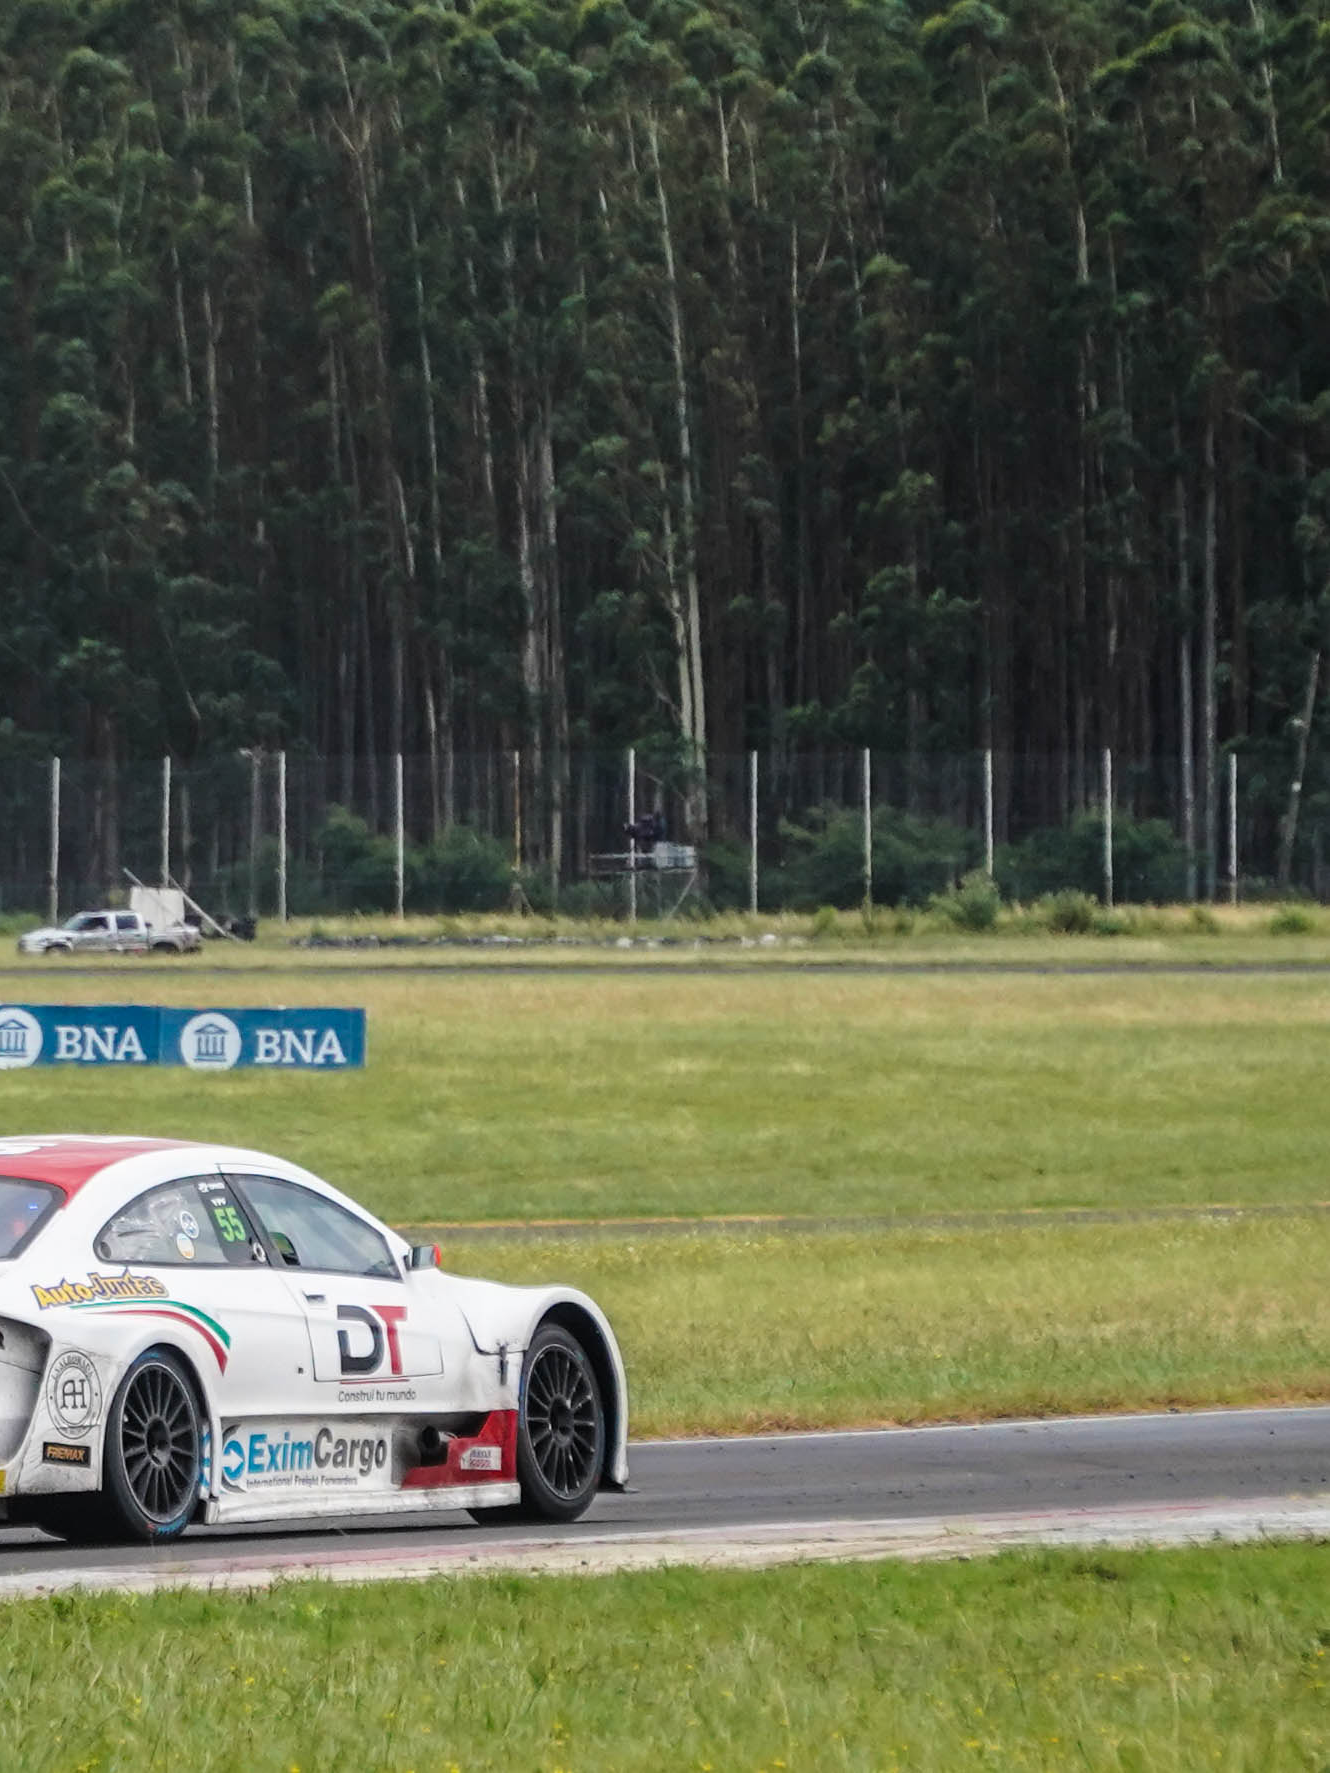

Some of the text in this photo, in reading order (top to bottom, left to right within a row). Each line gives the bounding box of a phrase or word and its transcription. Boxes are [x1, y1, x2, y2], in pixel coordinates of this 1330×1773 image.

[54, 1025, 147, 1062] BNA
[254, 1028, 347, 1065] BNA
[214, 1207, 246, 1242] 55
